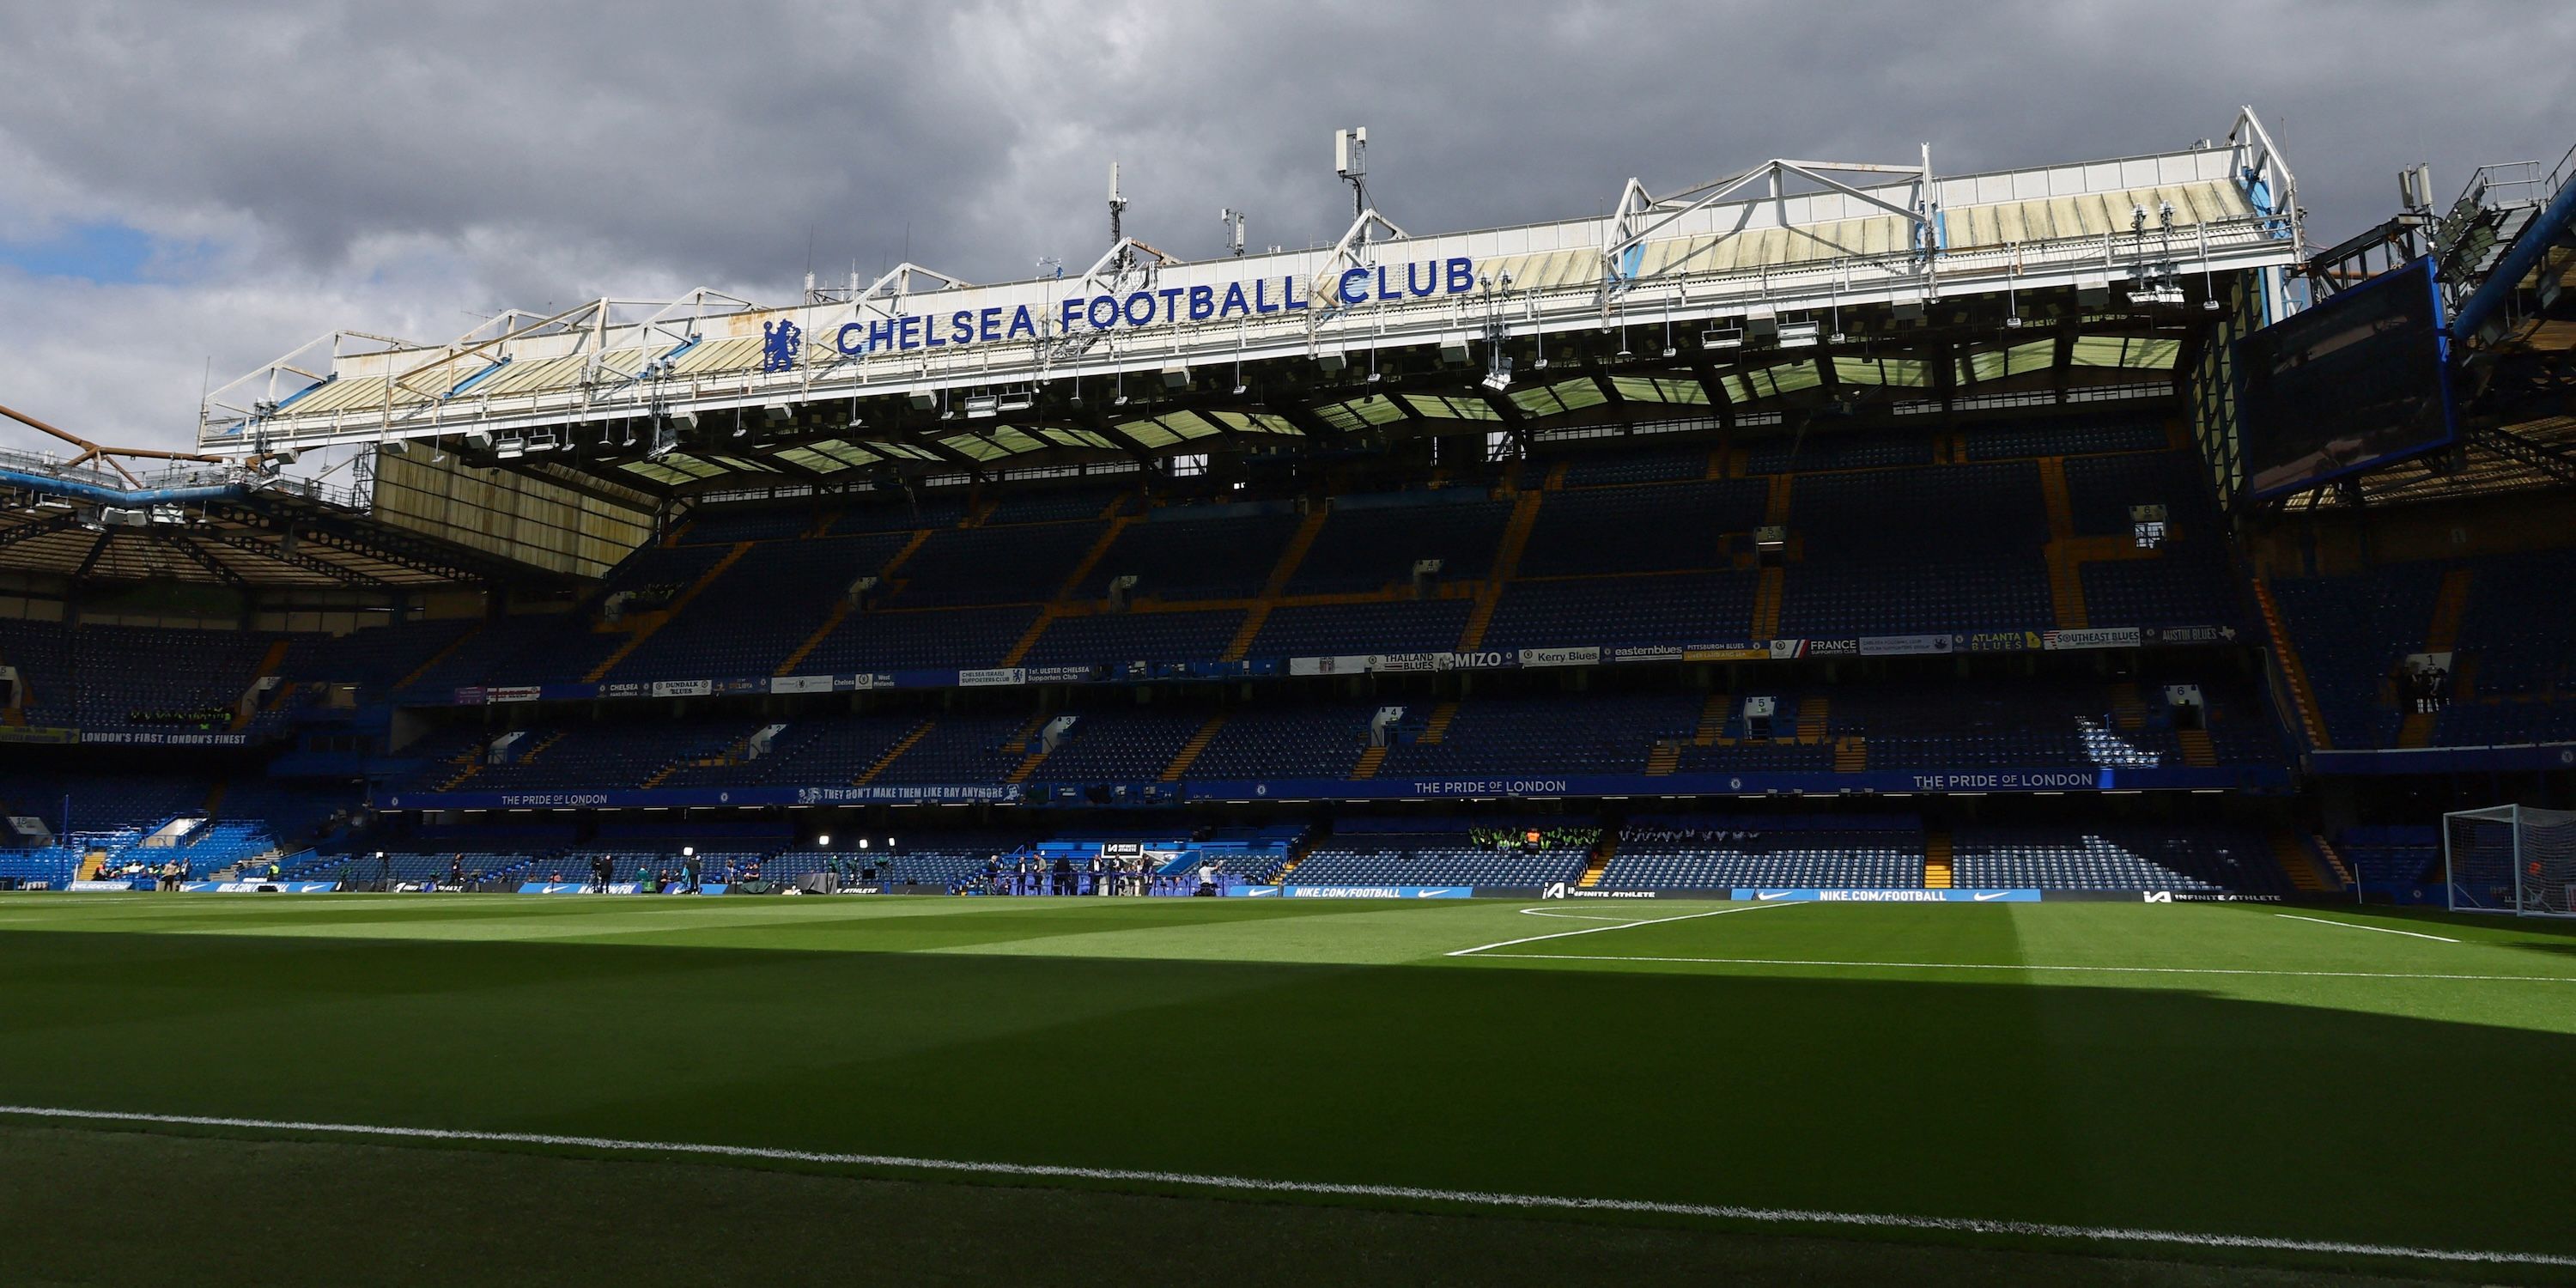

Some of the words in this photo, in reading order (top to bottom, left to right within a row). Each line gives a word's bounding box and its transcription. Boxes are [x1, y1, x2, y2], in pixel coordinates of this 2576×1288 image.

[837, 304, 1035, 355] CHELSEA
[1062, 274, 1309, 332] FOOTBALL
[1340, 257, 1473, 303] CLUB
[1972, 632, 2021, 642] ATLANTA
[2163, 629, 2190, 641] AUSTIN
[2192, 628, 2217, 639] BLUES
[1615, 645, 1682, 656] easternblues
[1810, 640, 1856, 650] FRANCE
[1971, 641, 2021, 650] BLUES
[1385, 653, 1433, 662] THAILAND
[1455, 652, 1501, 667] MIZO
[1538, 653, 1565, 662] Kerry
[1569, 652, 1597, 660] Blues
[1404, 661, 1433, 670] BLUES
[2177, 687, 2184, 696] 6
[1759, 698, 1765, 707] 5
[82, 732, 131, 743] LONDON'S
[167, 734, 212, 744] LONDON'S
[215, 734, 246, 744] FINEST
[1913, 775, 1944, 787] THE
[1949, 775, 1997, 787] PRIDE
[2002, 775, 2018, 787] OF
[2022, 773, 2093, 787] LONDON
[1414, 782, 1440, 793] THE
[1444, 781, 1485, 793] PRIDE
[1489, 781, 1503, 793] OF
[1505, 780, 1566, 793] LONDON
[824, 788, 843, 799] THEY
[846, 787, 871, 799] DON'T
[873, 787, 896, 799] MAKE
[898, 787, 921, 798] THEM
[923, 787, 942, 798] LIKE
[944, 787, 959, 798] RAY
[961, 787, 1003, 798] ANYMORE
[501, 796, 519, 805] THE
[522, 795, 550, 805] PRIDE
[553, 795, 563, 804] OF
[565, 794, 607, 805] LONDON
[1295, 888, 1400, 898] NIKE.COM/FOOTBALL
[1820, 890, 1947, 902] NIKE.COM/FOOTBALL
